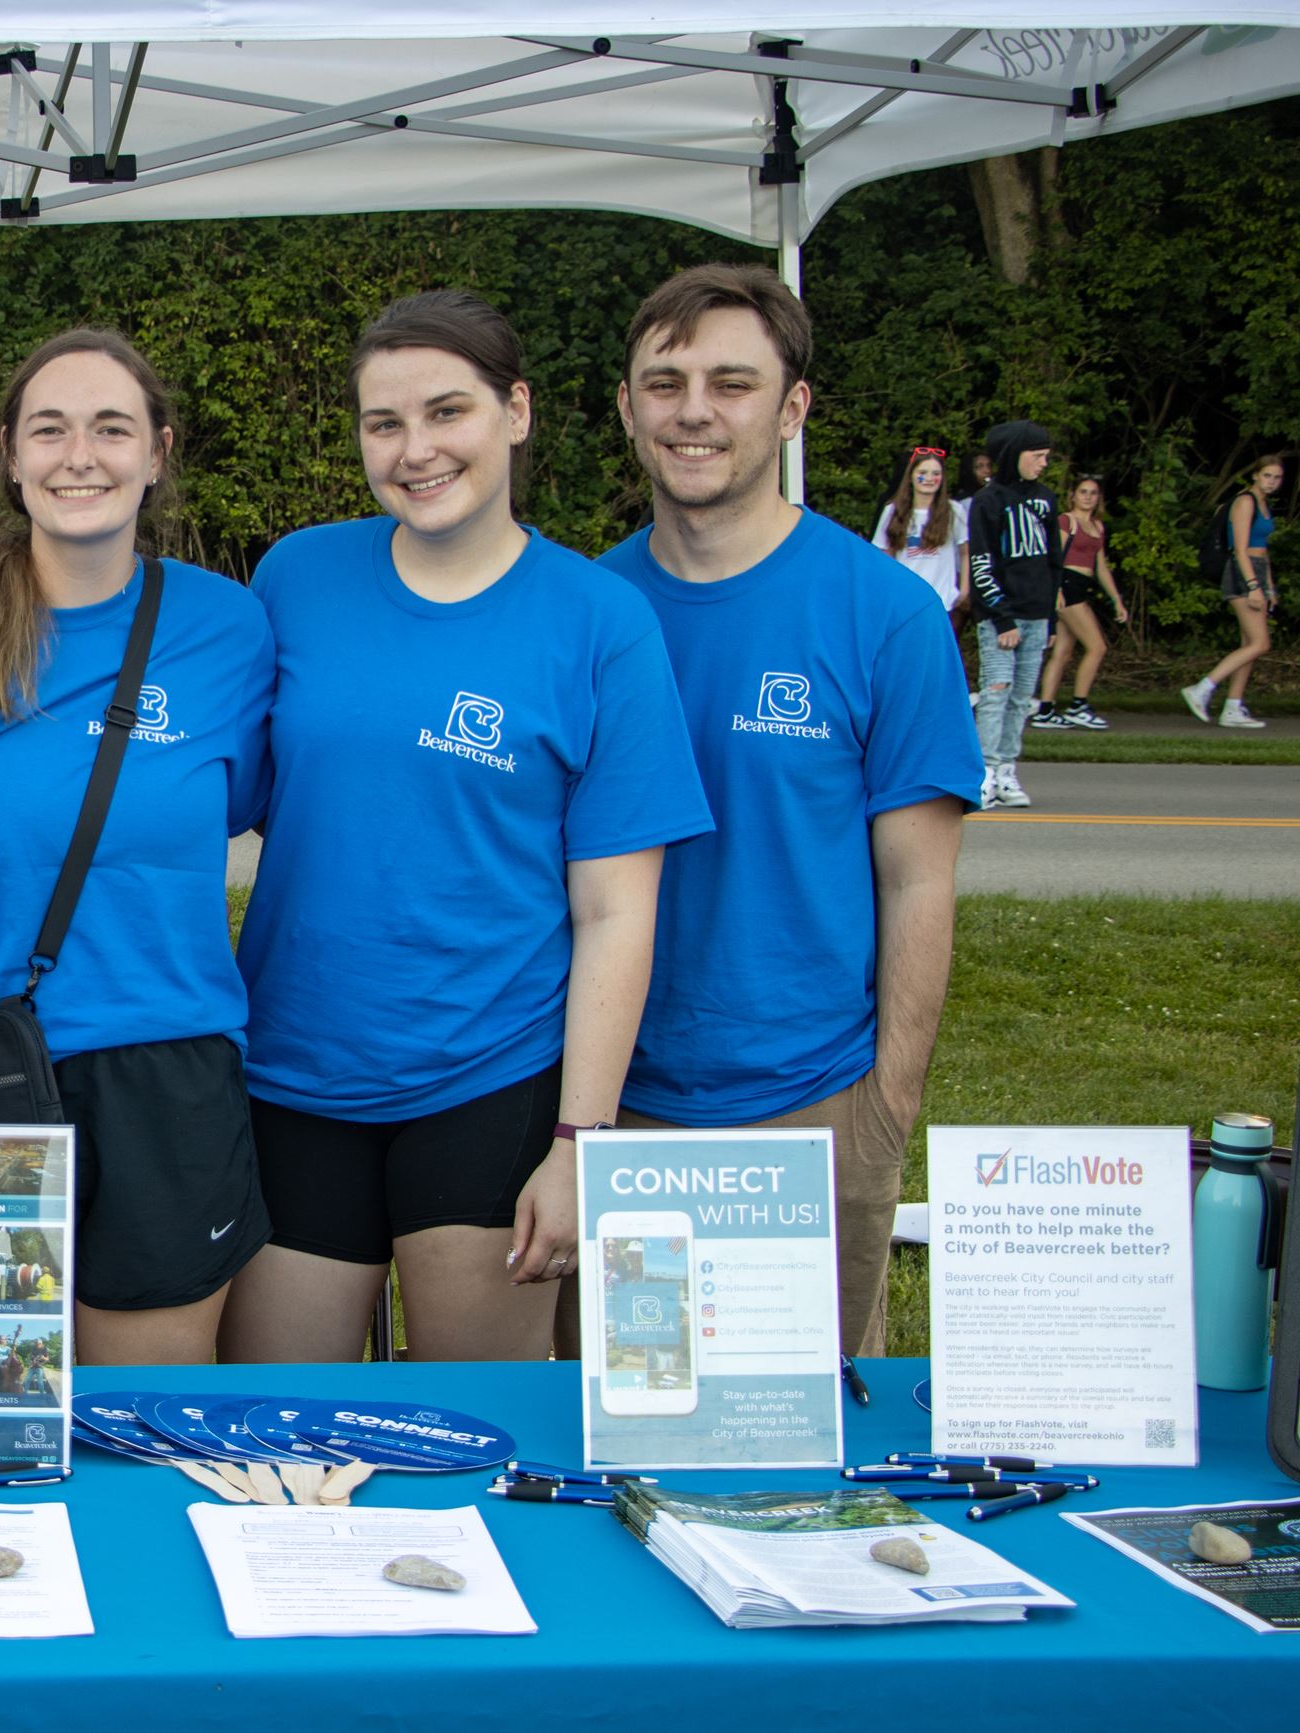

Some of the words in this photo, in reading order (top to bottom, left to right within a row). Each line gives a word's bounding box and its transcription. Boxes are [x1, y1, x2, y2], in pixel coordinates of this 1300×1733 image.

[87, 720, 191, 744] Bercreek
[731, 714, 832, 740] Beavercreek
[416, 727, 517, 774] Beavercreek
[1014, 1155, 1143, 1185] FlashVote
[610, 1166, 785, 1195] CONNECT
[7, 1205, 28, 1213] FOR
[697, 1203, 771, 1225] WITH
[775, 1203, 820, 1225] US!
[944, 1203, 968, 1216] Do
[971, 1205, 1002, 1219] you
[1005, 1203, 1046, 1216] have
[1049, 1206, 1081, 1216] one
[1084, 1203, 1142, 1216] minute
[944, 1225, 955, 1234] a
[958, 1222, 1012, 1235] month
[1015, 1223, 1034, 1235] to
[1037, 1223, 1074, 1238] help
[1077, 1223, 1124, 1235] make
[1126, 1223, 1155, 1235] the
[944, 1242, 978, 1257] City
[981, 1242, 1000, 1254] of
[1003, 1242, 1107, 1255] Beavercreek
[1109, 1242, 1171, 1255] better?
[945, 1272, 1018, 1283] Beavercreek
[1020, 1272, 1045, 1286] City
[1047, 1273, 1094, 1284] Council
[1095, 1273, 1119, 1284] and
[1121, 1273, 1144, 1287] city
[1146, 1273, 1174, 1284] staff
[945, 1286, 975, 1297] want
[976, 1286, 991, 1297] to
[992, 1287, 1020, 1297] hear
[1022, 1287, 1052, 1297] from
[1054, 1287, 1080, 1300] you!
[620, 1321, 676, 1332] Beavercreek
[722, 1390, 746, 1402] Stay
[748, 1389, 805, 1402] up-to-date
[735, 1402, 758, 1412] with
[759, 1402, 795, 1412] what's
[334, 1411, 498, 1445] CONNECT
[720, 1415, 776, 1427] happening
[778, 1415, 789, 1424] in
[790, 1415, 809, 1424] the
[947, 1419, 959, 1428] To
[960, 1419, 982, 1430] sign
[982, 1421, 997, 1430] up
[997, 1419, 1013, 1428] for
[1014, 1419, 1066, 1430] FlashVote,
[1067, 1419, 1088, 1429] visit
[712, 1428, 734, 1440] City
[735, 1428, 748, 1438] of
[749, 1428, 818, 1438] Beavercreek!
[947, 1430, 1125, 1441] www.flashvote.com/beavercreekohio
[14, 1439, 58, 1449] Beavercreek
[947, 1442, 958, 1450] or
[959, 1441, 977, 1450] call
[978, 1441, 1006, 1451] (775)
[1007, 1441, 1057, 1451] 235-2240.
